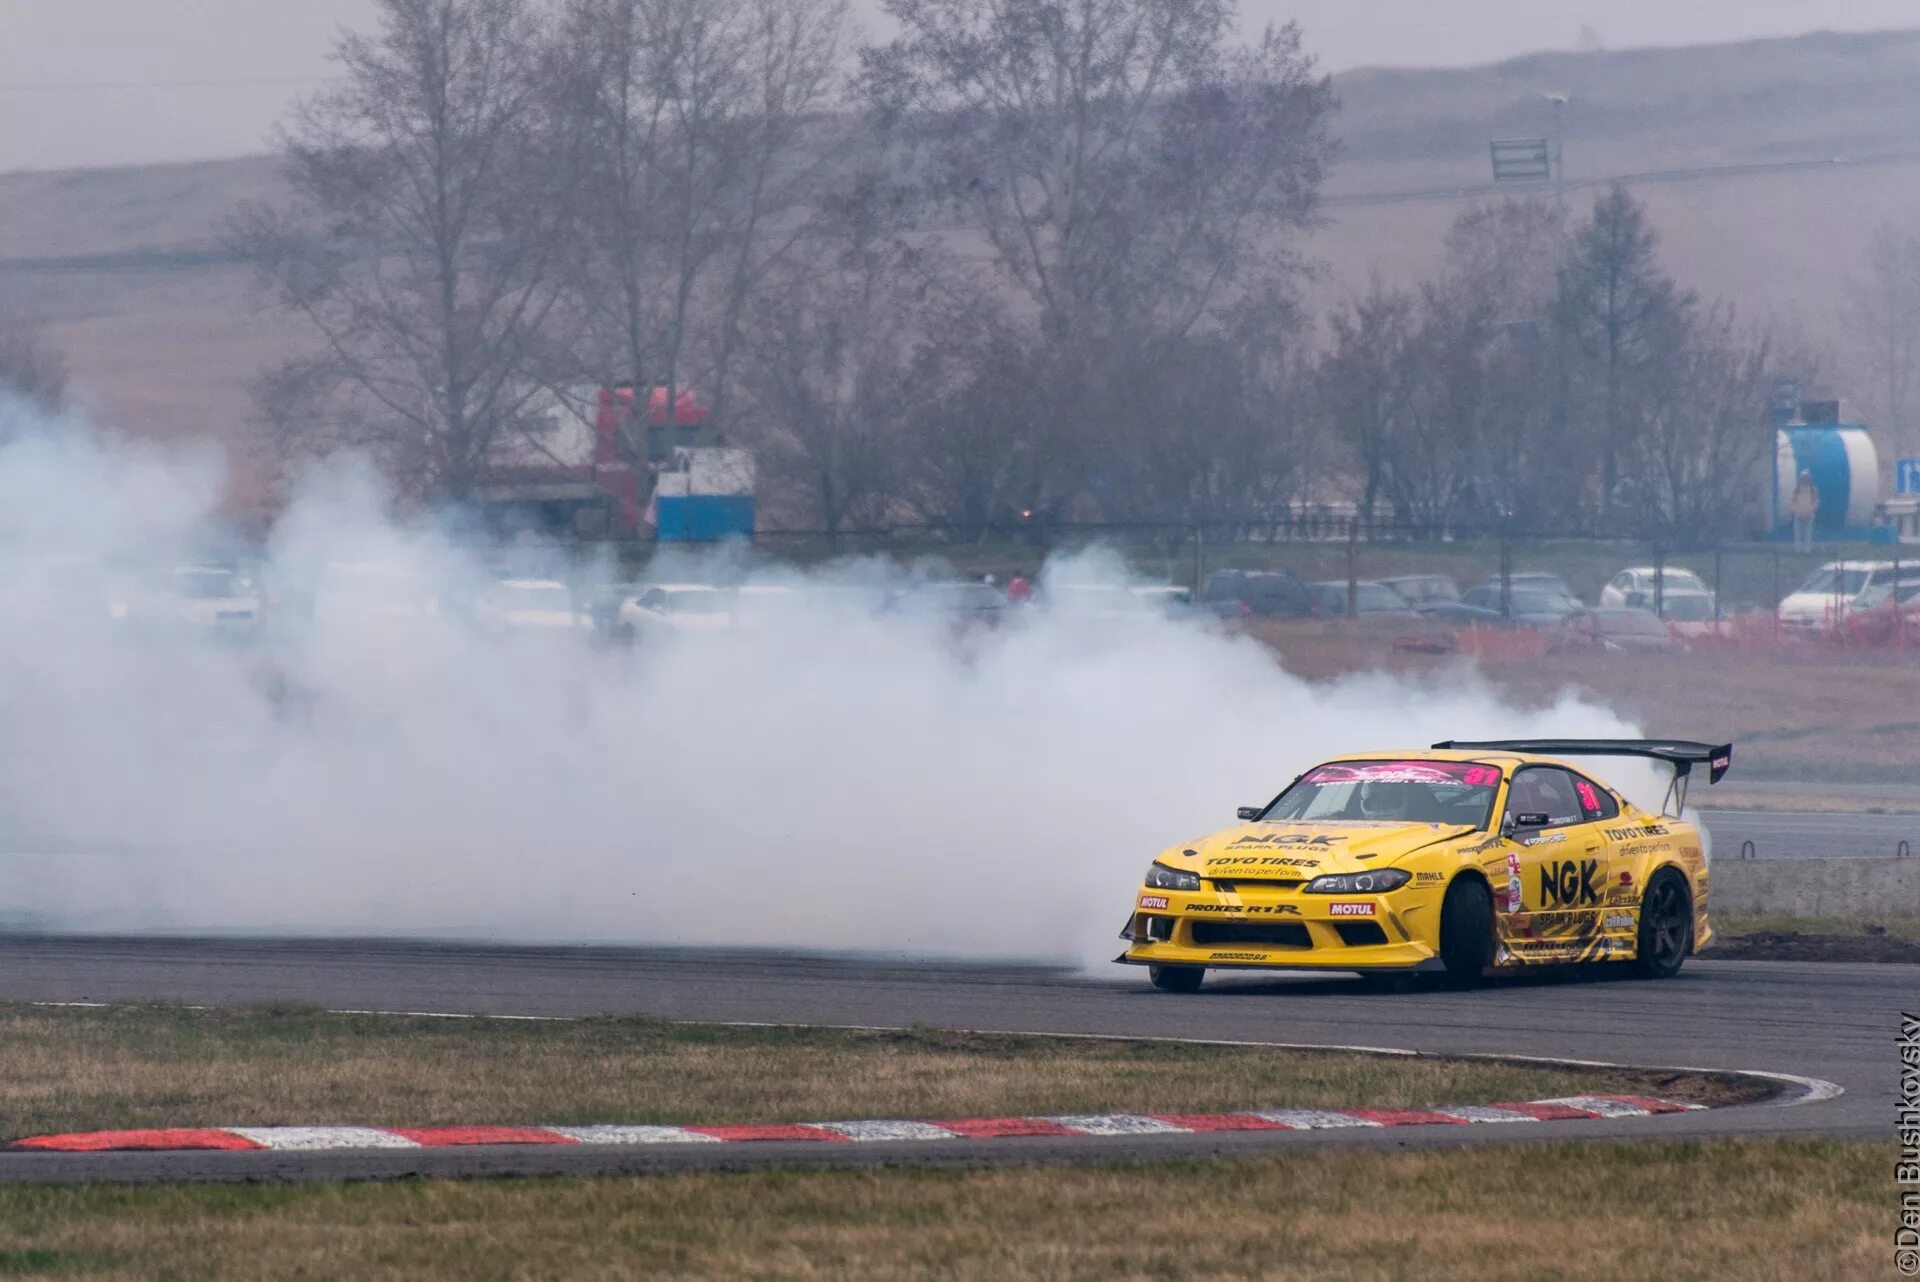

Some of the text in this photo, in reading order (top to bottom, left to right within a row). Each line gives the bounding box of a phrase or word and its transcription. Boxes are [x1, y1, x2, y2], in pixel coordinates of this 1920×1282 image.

[1604, 824, 1670, 841] TOYO TIRES
[1231, 834, 1348, 846] NGK
[1206, 857, 1321, 868] TOYO TIRES
[1208, 866, 1244, 876] driven
[1255, 867, 1302, 877] perform
[1416, 872, 1445, 881] MAHLE
[1540, 859, 1599, 907] NGK
[1140, 897, 1168, 909] MOTUL
[1185, 903, 1243, 913] PROXES
[1330, 904, 1374, 915] MOTUL
